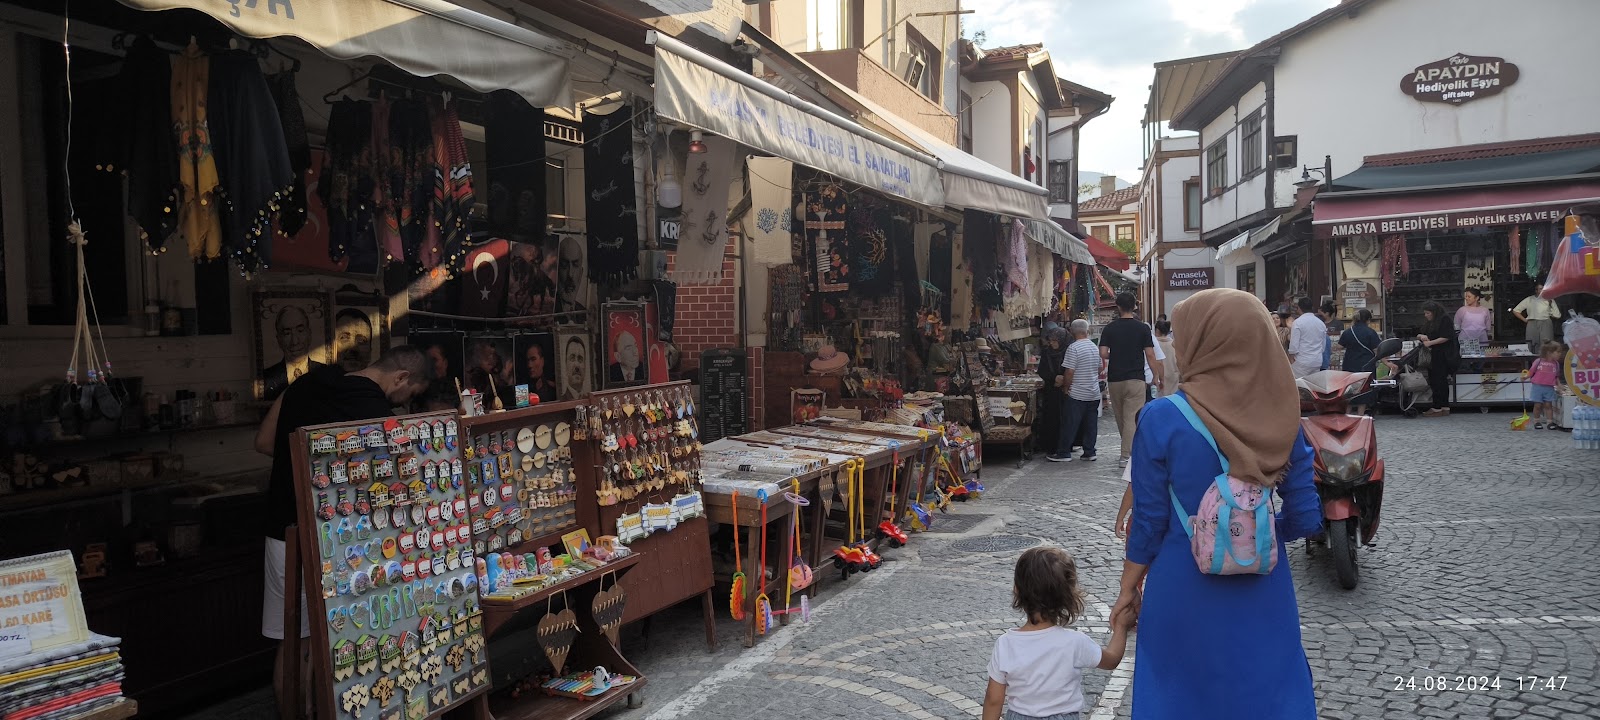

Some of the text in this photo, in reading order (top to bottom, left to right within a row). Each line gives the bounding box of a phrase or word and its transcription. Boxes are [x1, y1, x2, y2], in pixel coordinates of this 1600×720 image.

[1413, 62, 1500, 82] APAYDIN
[1416, 78, 1500, 93] Hediyelik Eşya
[1442, 90, 1475, 100] gift shop
[848, 144, 861, 165] EL
[865, 151, 911, 183] SANATLARI
[1331, 222, 1377, 236] AMASYA
[1381, 214, 1449, 232] BELEDİYESİ
[1457, 213, 1507, 226] HEDİYELİK
[1508, 212, 1532, 224] EŞYA
[1534, 211, 1547, 220] VE
[1170, 279, 1190, 287] Butik
[23, 584, 68, 604] ÖRTÜSÜ
[22, 609, 53, 625] KARE
